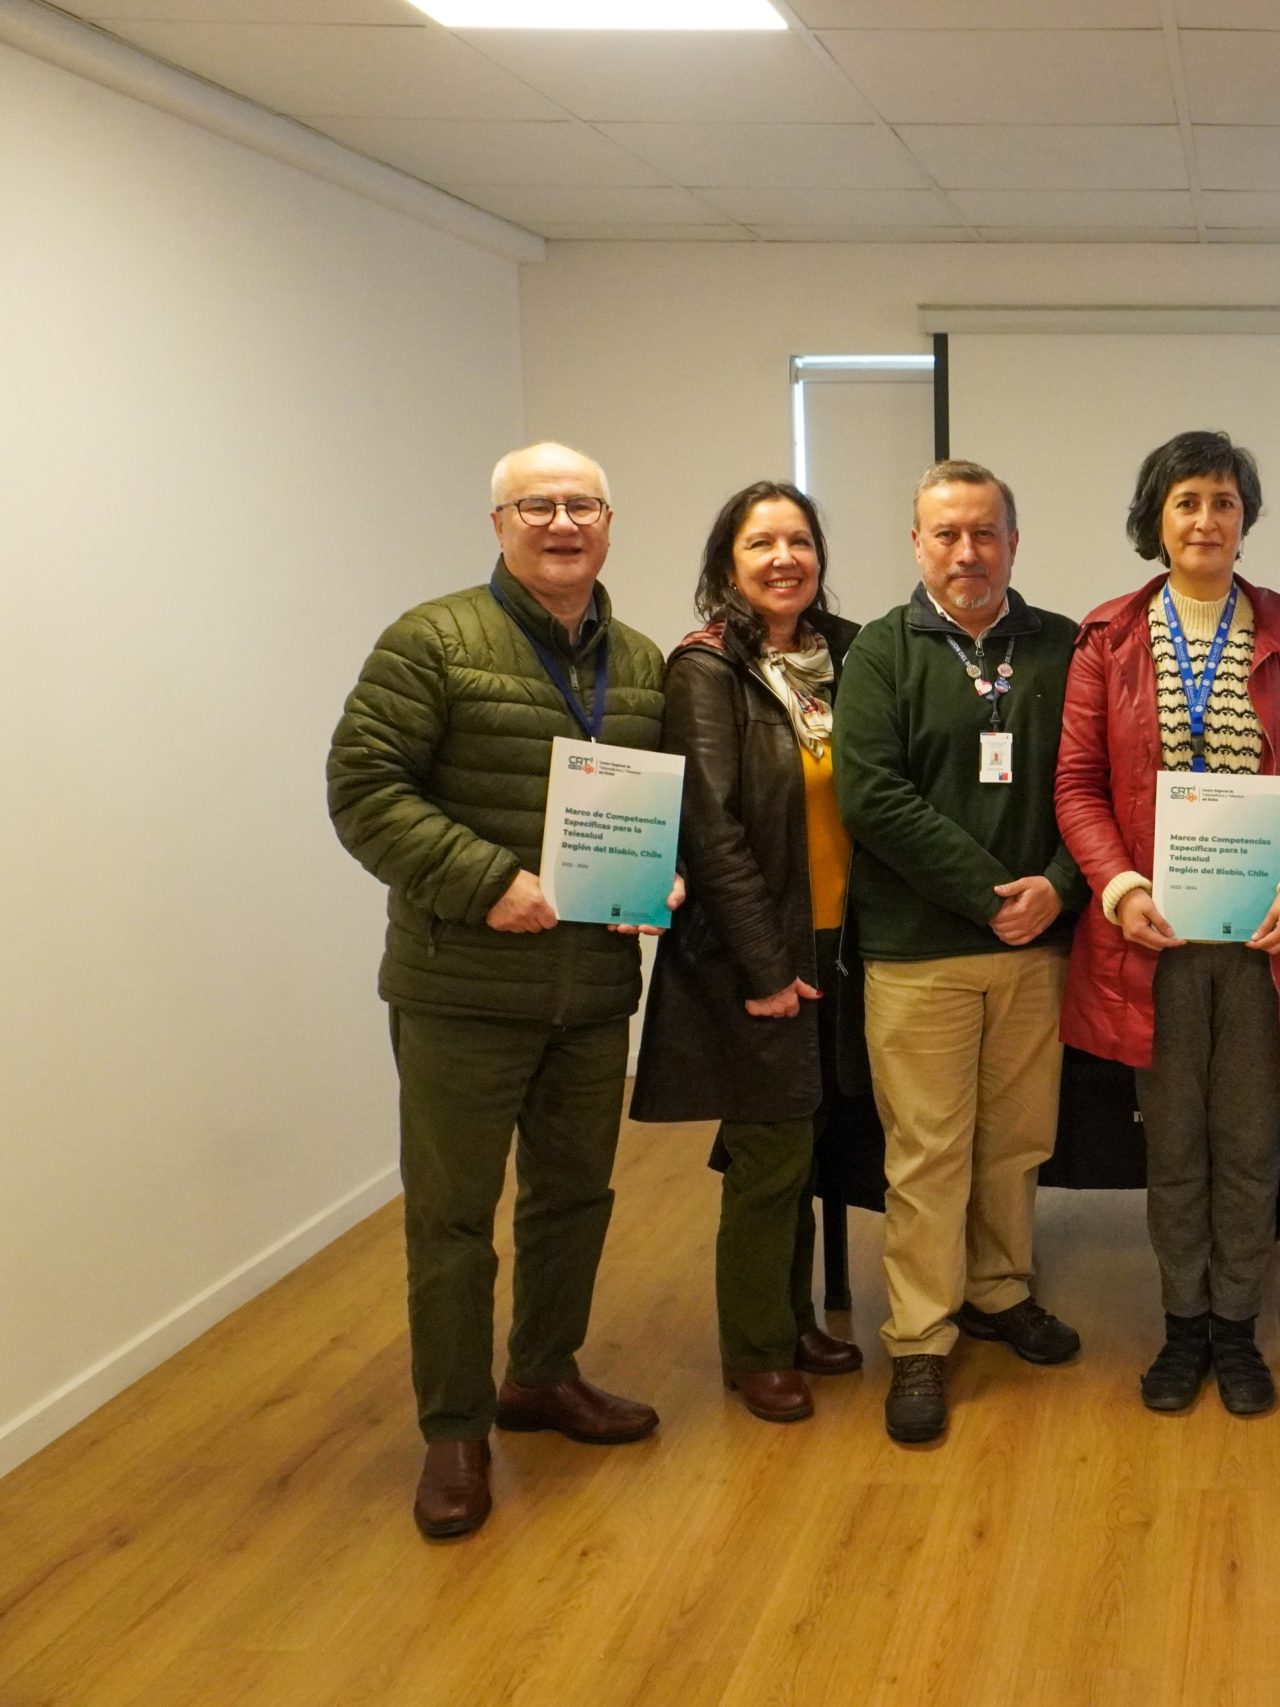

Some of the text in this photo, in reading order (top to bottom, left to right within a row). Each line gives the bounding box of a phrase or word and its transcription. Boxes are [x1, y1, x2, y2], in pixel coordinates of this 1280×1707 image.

[569, 756, 589, 765] CRT
[565, 807, 590, 817] Marco
[606, 812, 666, 825] Competencias
[564, 818, 641, 834] Específicas para la
[563, 829, 603, 840] Telesalud
[1211, 836, 1271, 845] Competencias
[562, 841, 591, 851] Región
[609, 846, 638, 857] Biobío,
[641, 850, 662, 858] Chile
[1170, 844, 1217, 853] Específicas
[1169, 866, 1198, 874] Región
[1201, 867, 1214, 875] del
[1216, 868, 1245, 877] Biobío,
